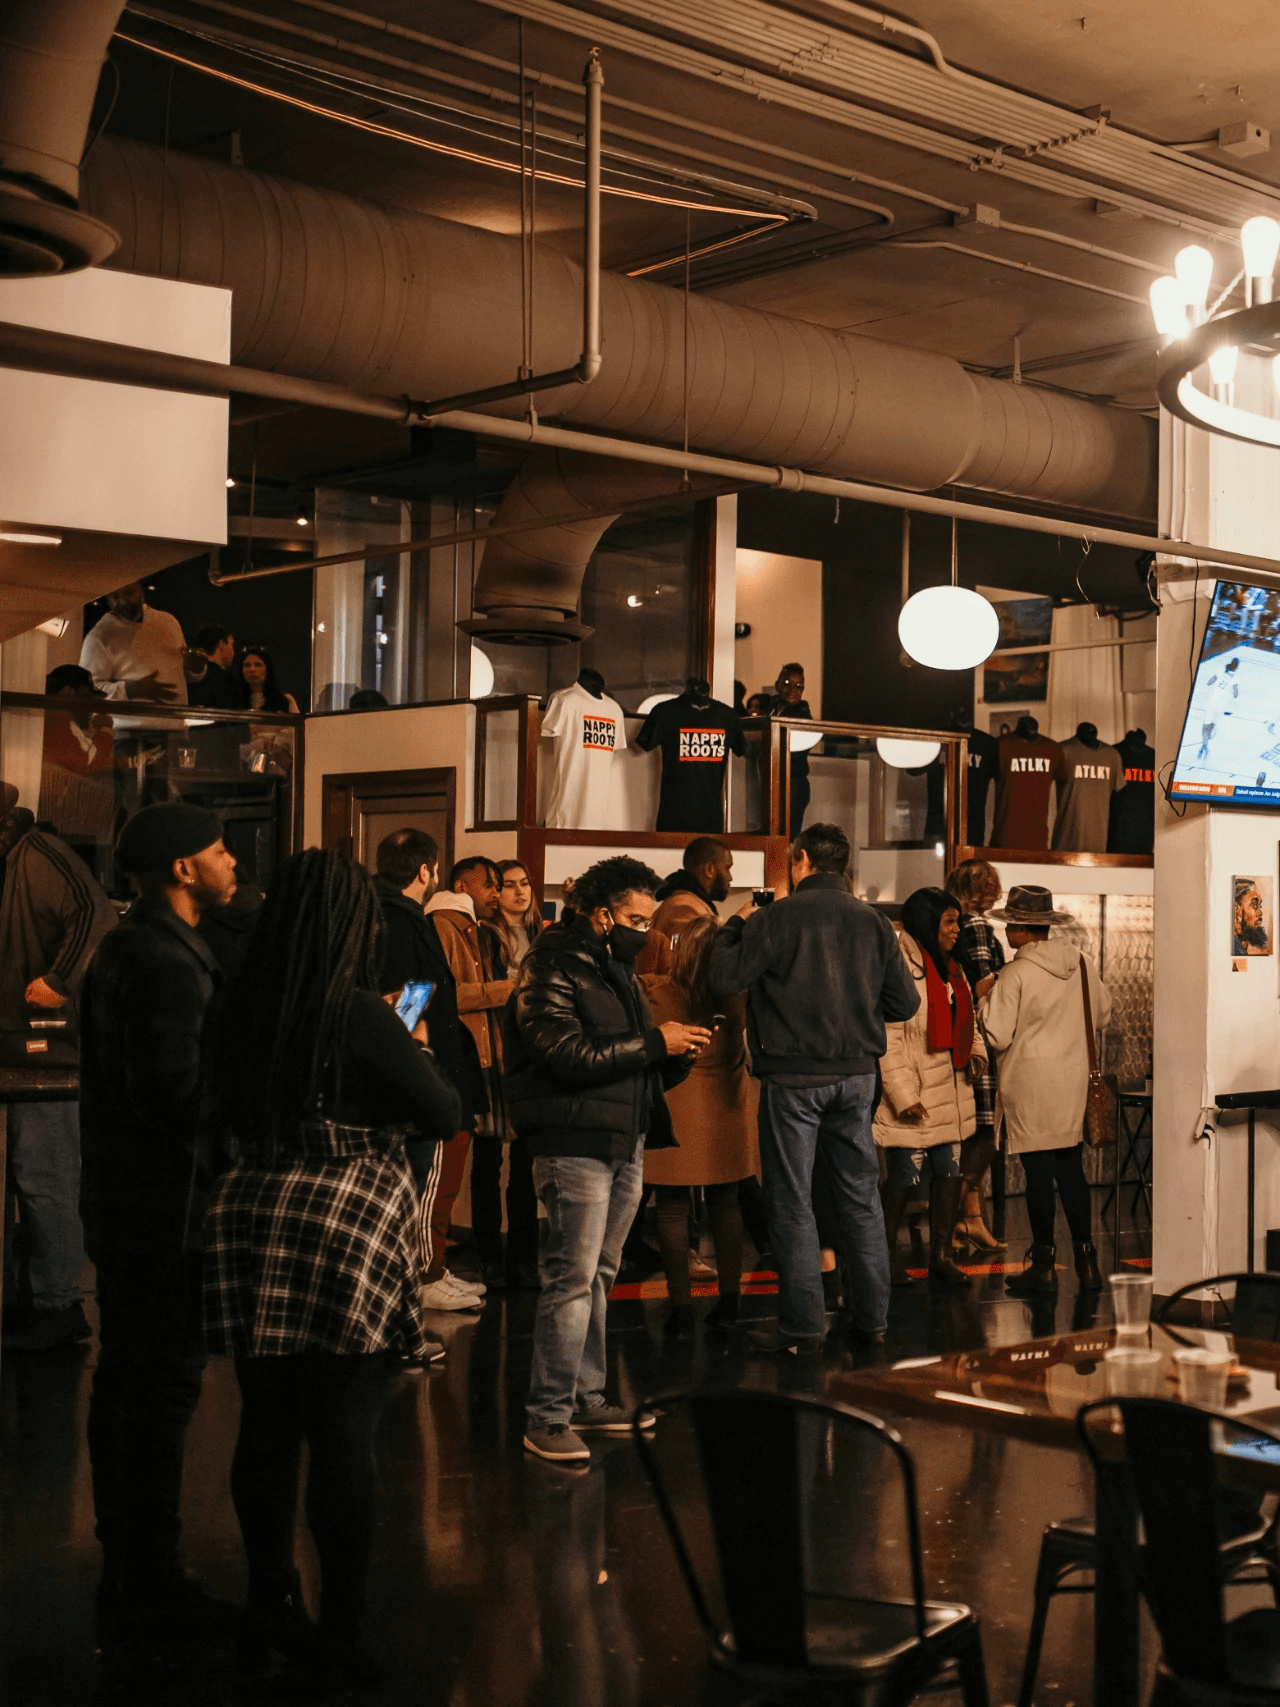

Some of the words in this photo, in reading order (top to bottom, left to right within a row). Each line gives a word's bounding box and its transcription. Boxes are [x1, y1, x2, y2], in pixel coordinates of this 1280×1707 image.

[583, 720, 616, 735] NAPPY
[583, 731, 616, 747] ROOTS
[679, 733, 726, 746] NAPPY
[679, 745, 726, 757] ROOTS
[1010, 757, 1051, 773] ATLKY
[1074, 764, 1111, 780] ATLKY
